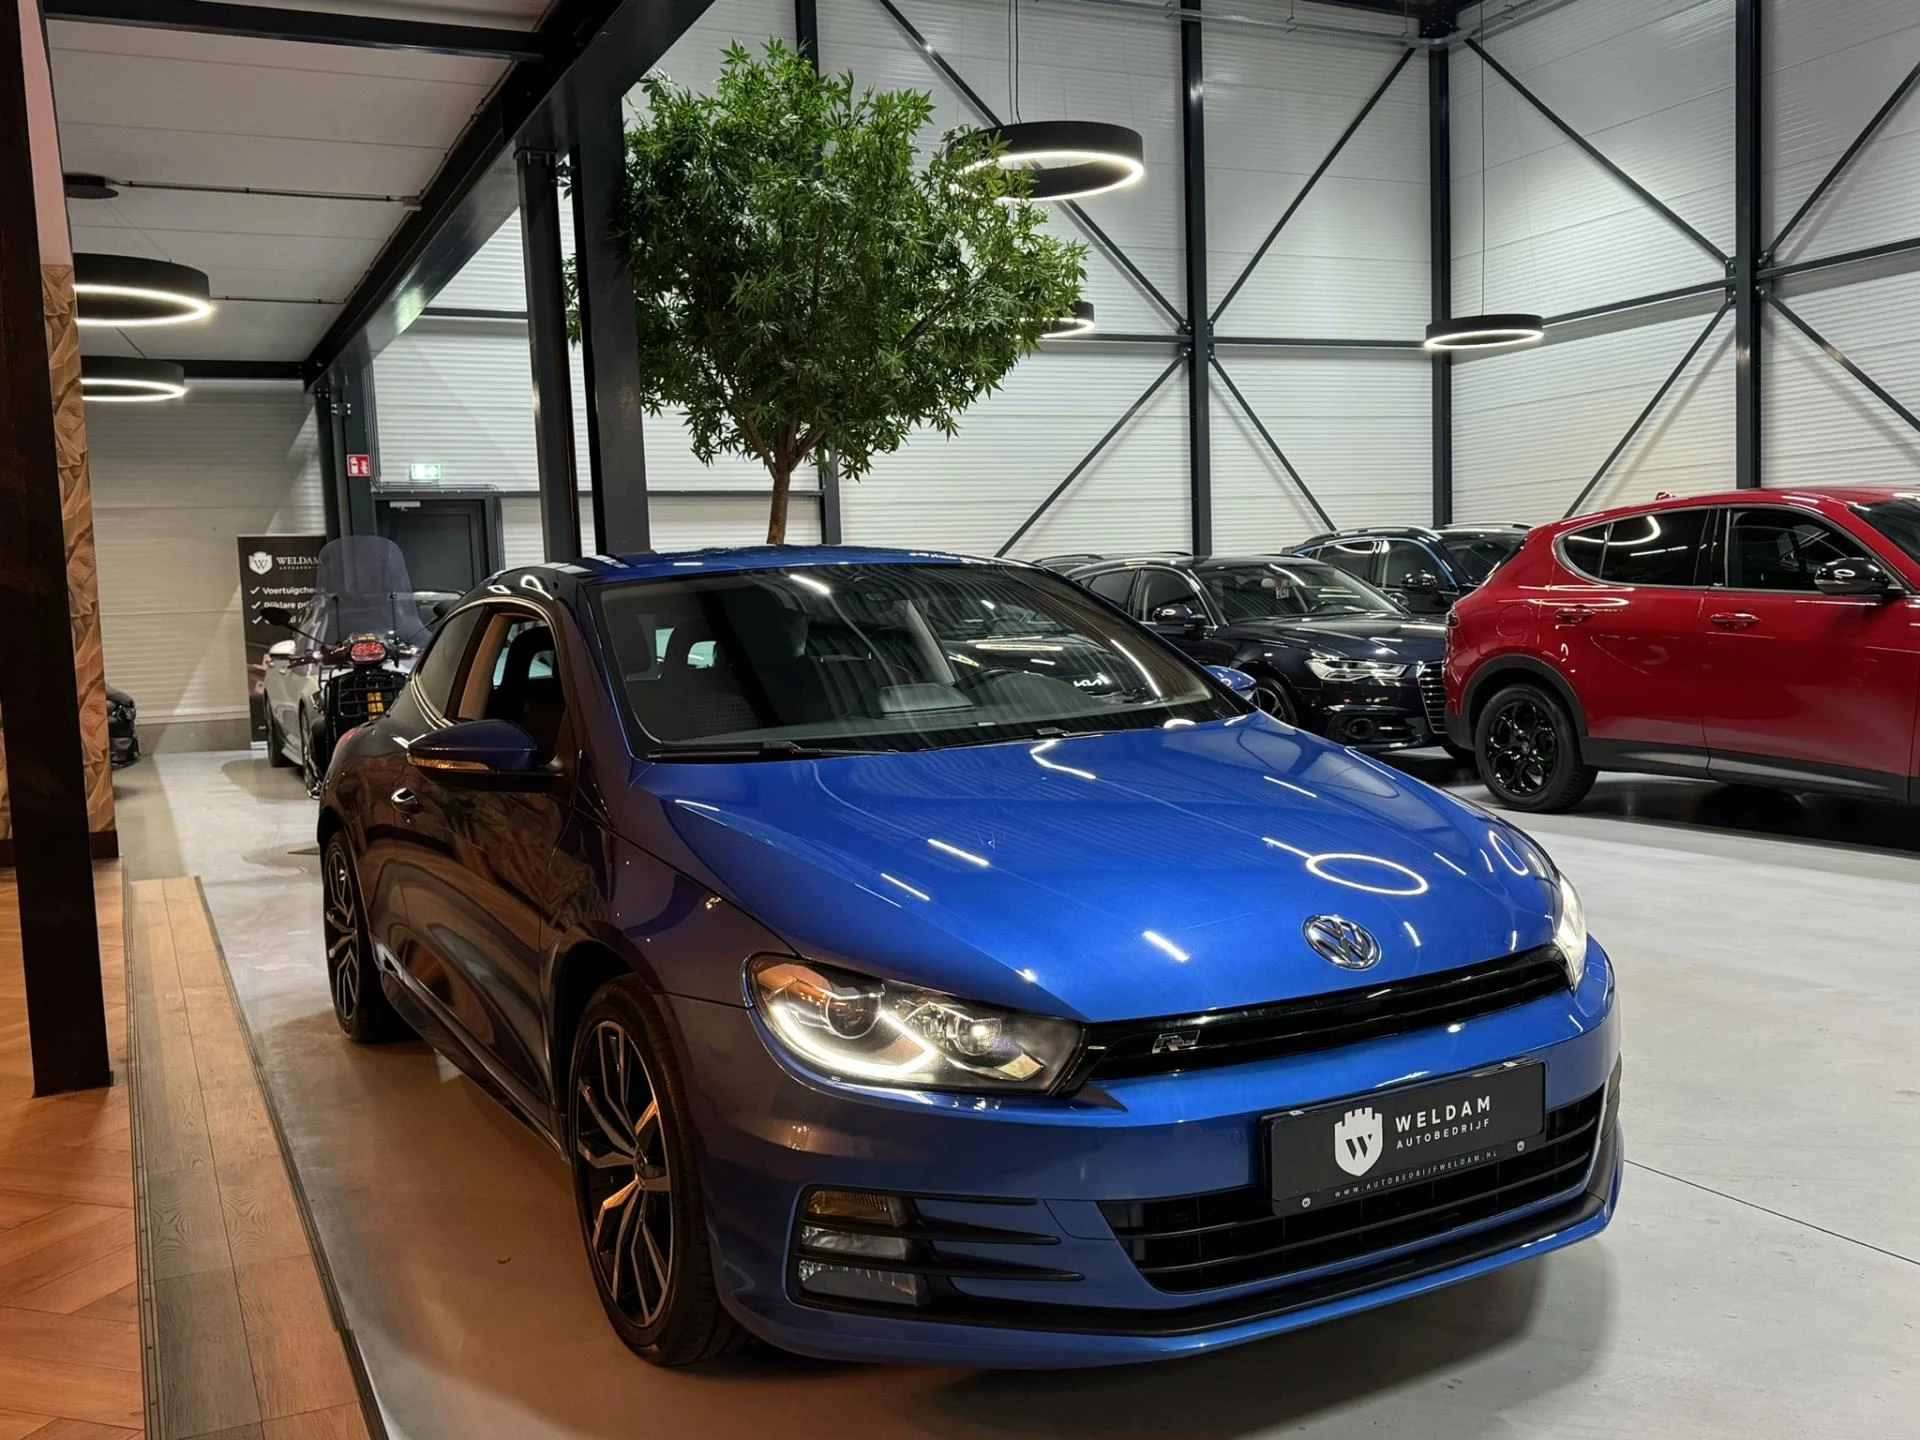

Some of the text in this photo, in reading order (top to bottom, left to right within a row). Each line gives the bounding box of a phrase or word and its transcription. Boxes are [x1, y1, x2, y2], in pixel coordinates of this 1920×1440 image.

[1395, 1096, 1490, 1133] WELDAM
[1396, 1118, 1490, 1150] AUTOBEDRIJF
[1335, 1151, 1498, 1198] WWW.AUTOBEDRIJFWELDAM.NL
